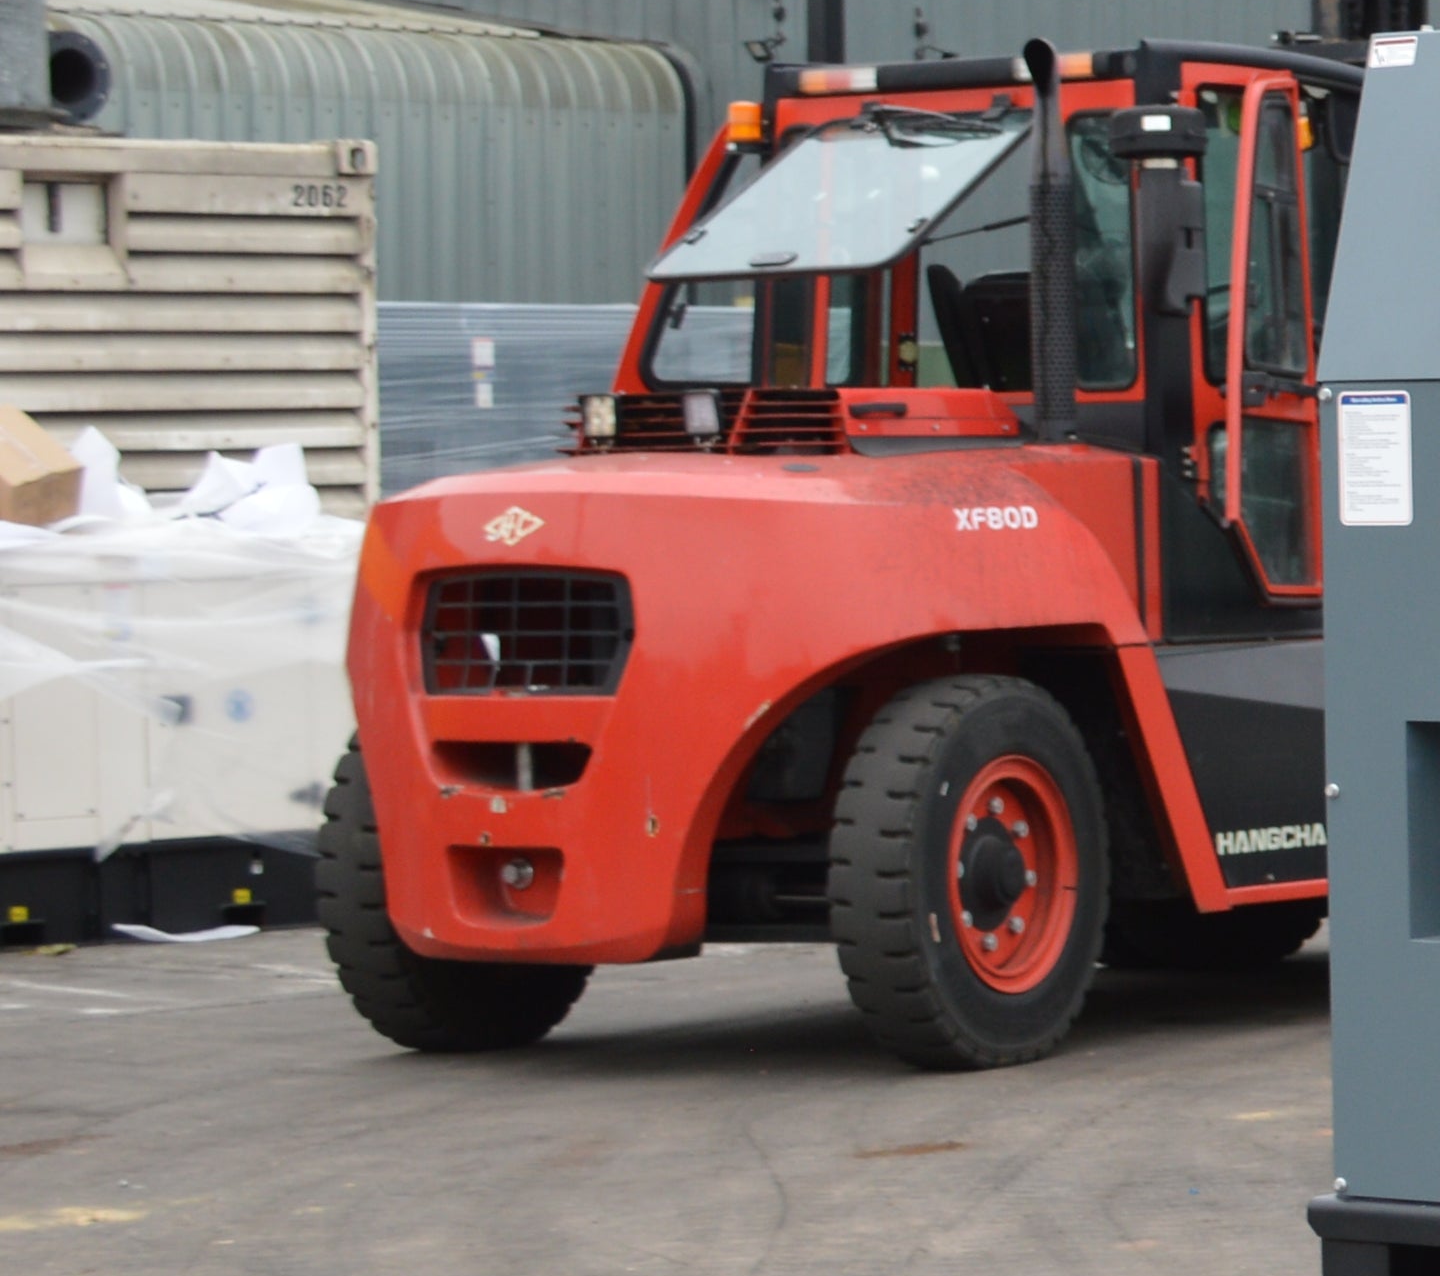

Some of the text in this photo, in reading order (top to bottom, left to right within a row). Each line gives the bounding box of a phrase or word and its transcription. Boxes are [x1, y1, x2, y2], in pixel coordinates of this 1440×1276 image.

[292, 184, 348, 208] 2062
[952, 505, 1039, 531] XF80D
[1215, 822, 1327, 856] HANGCHA
